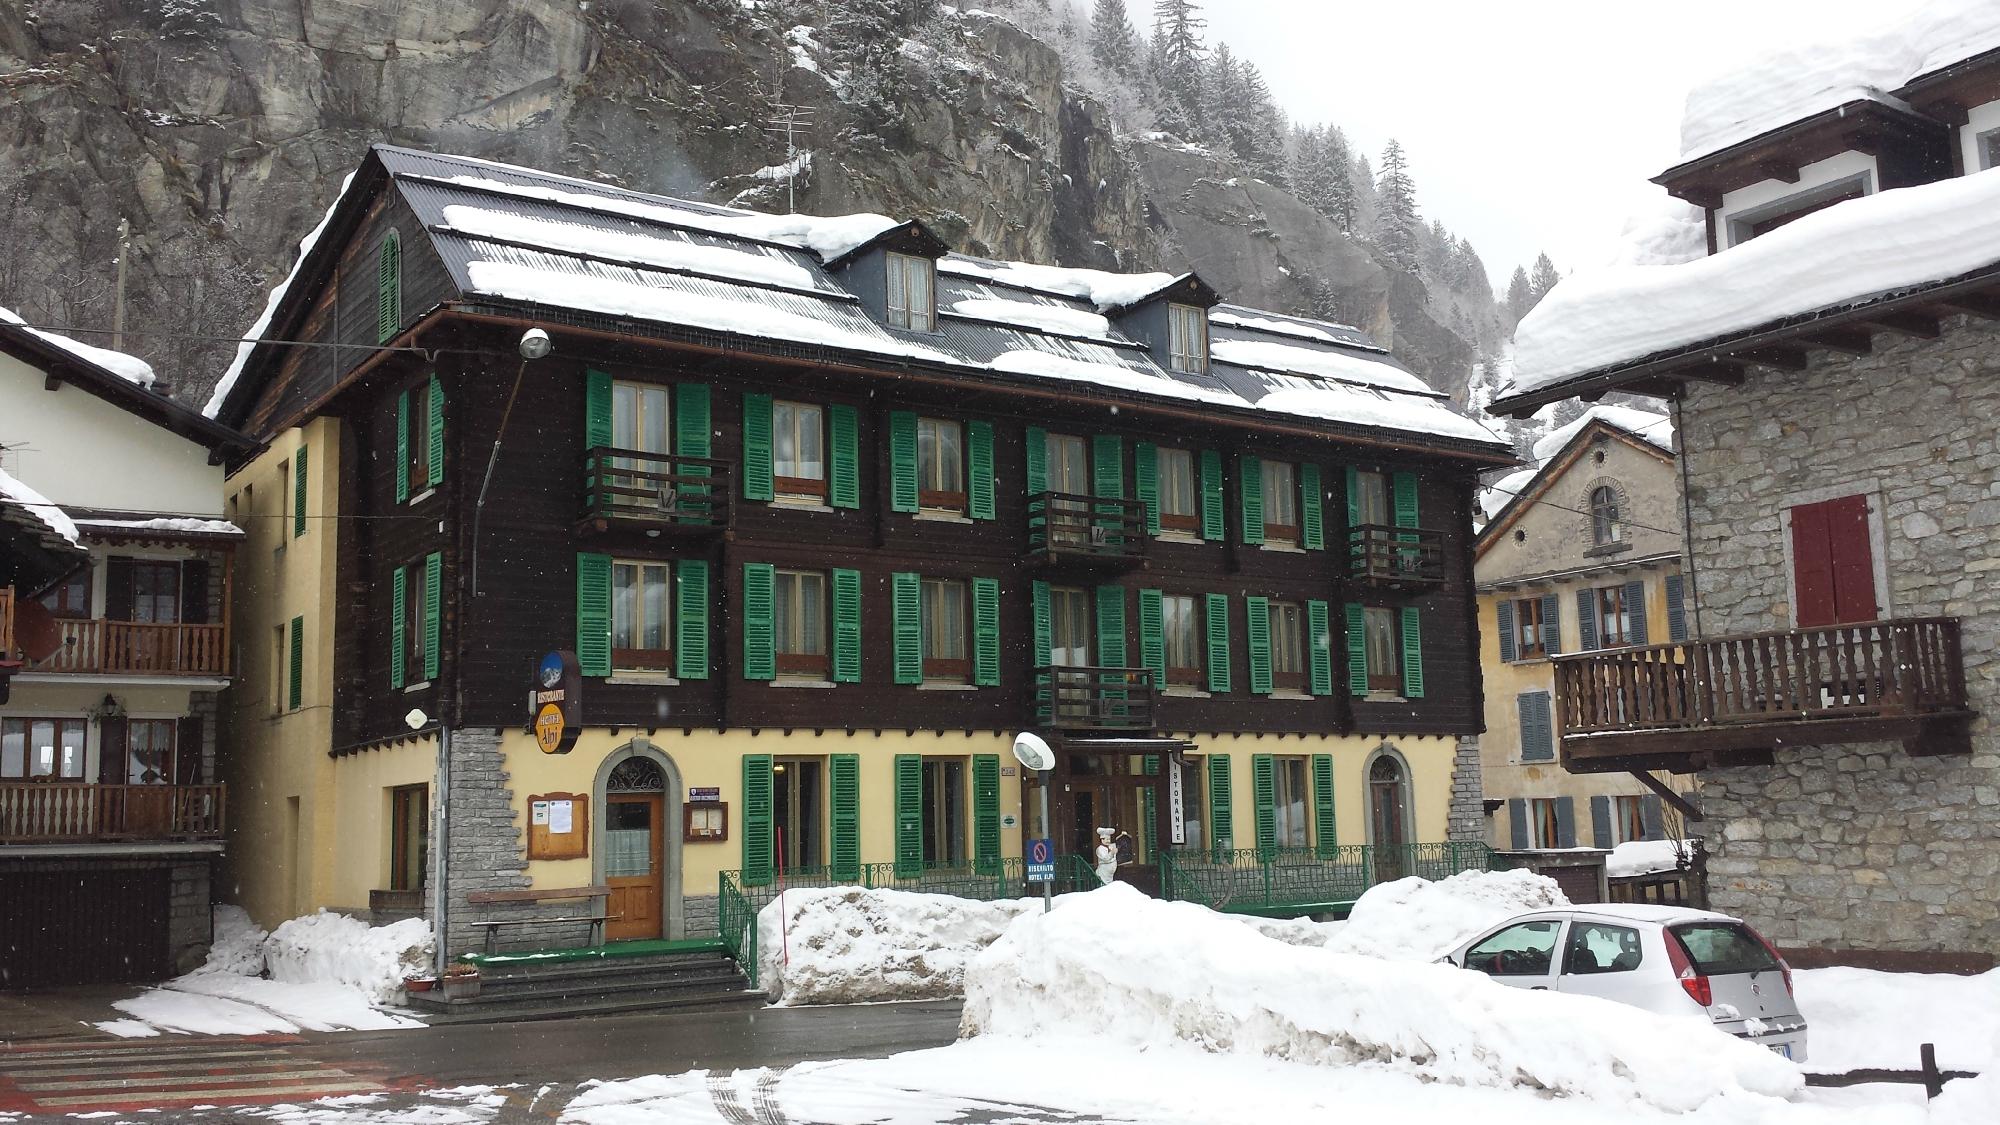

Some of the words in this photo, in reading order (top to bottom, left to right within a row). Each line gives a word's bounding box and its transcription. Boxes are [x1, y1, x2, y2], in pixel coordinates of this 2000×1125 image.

[541, 714, 560, 726] HOTEL
[541, 727, 558, 749] Alpi
[1172, 764, 1181, 841] ISTORANTE
